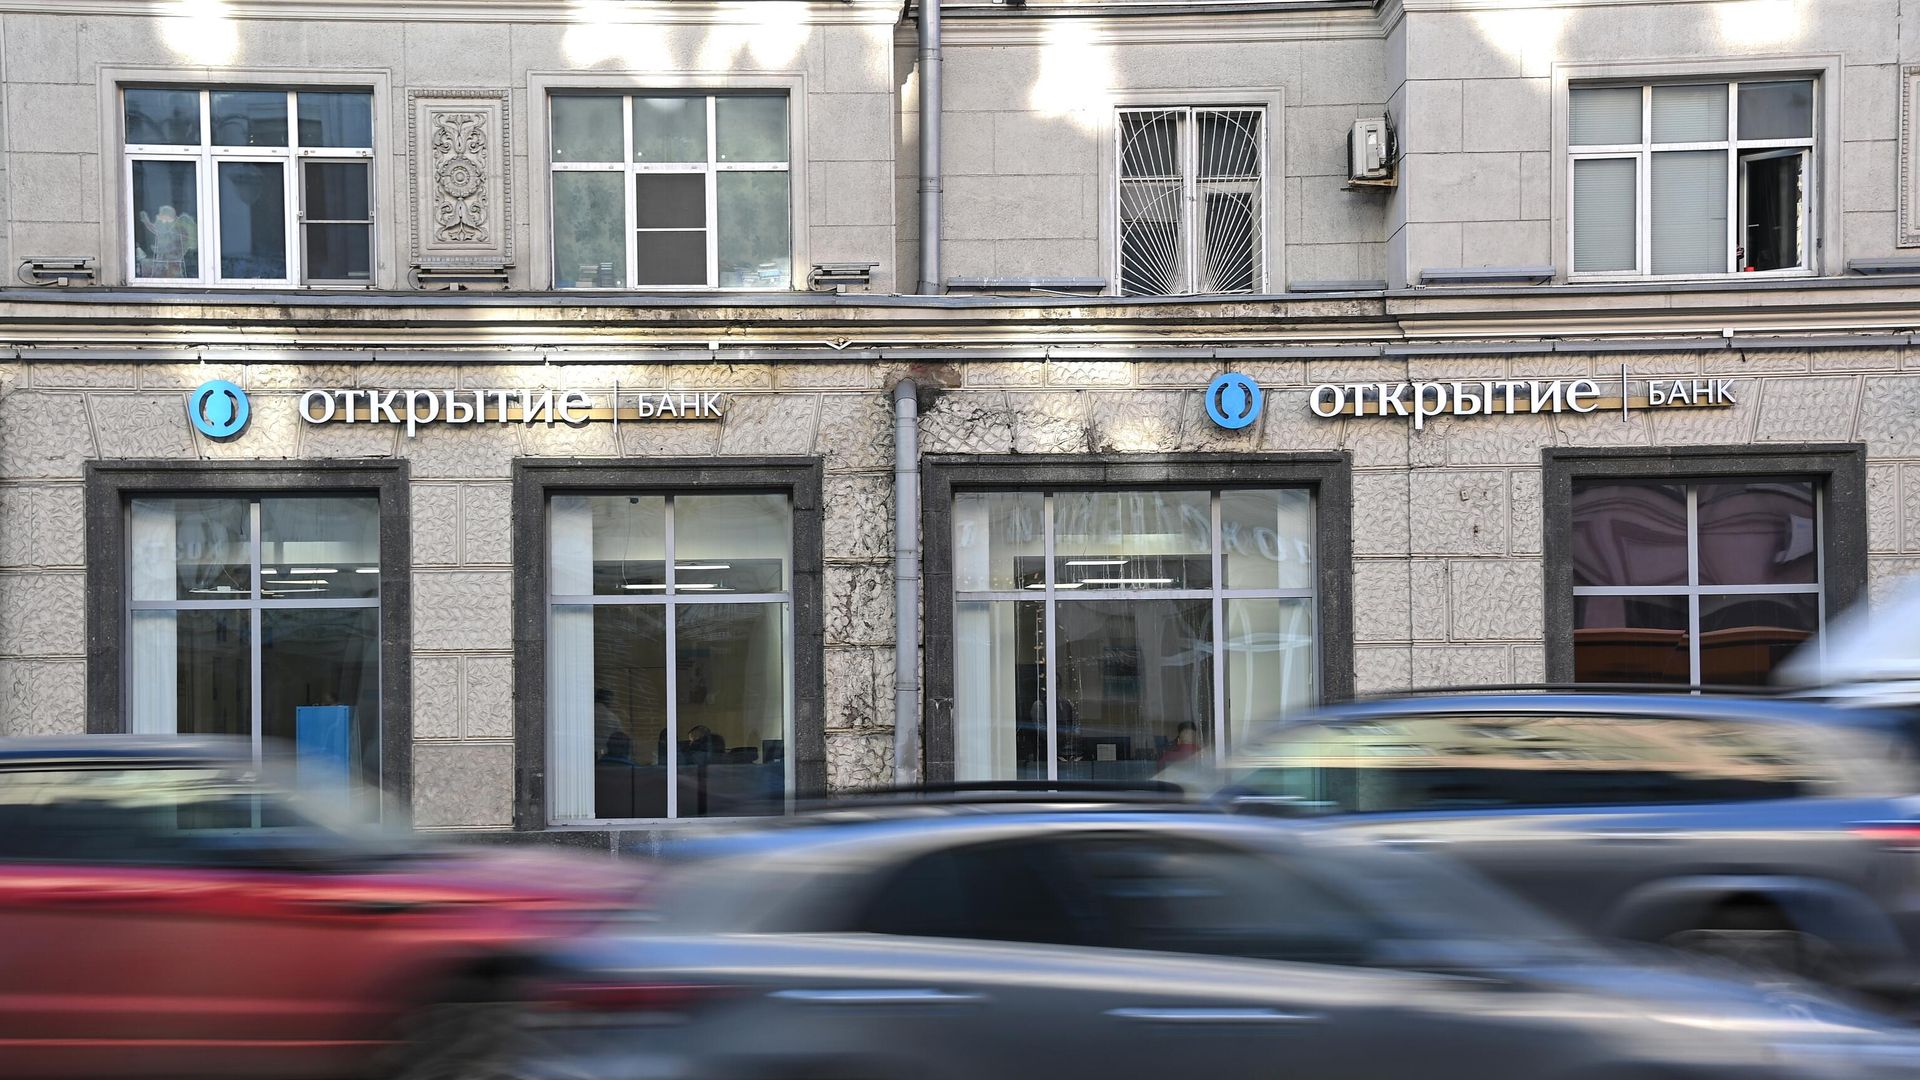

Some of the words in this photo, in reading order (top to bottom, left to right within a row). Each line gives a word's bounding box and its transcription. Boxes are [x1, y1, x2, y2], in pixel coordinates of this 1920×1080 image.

[299, 387, 593, 438] открытие
[638, 392, 723, 418] БАНК
[1309, 377, 1601, 430] открытие
[1647, 378, 1736, 405] БАНК
